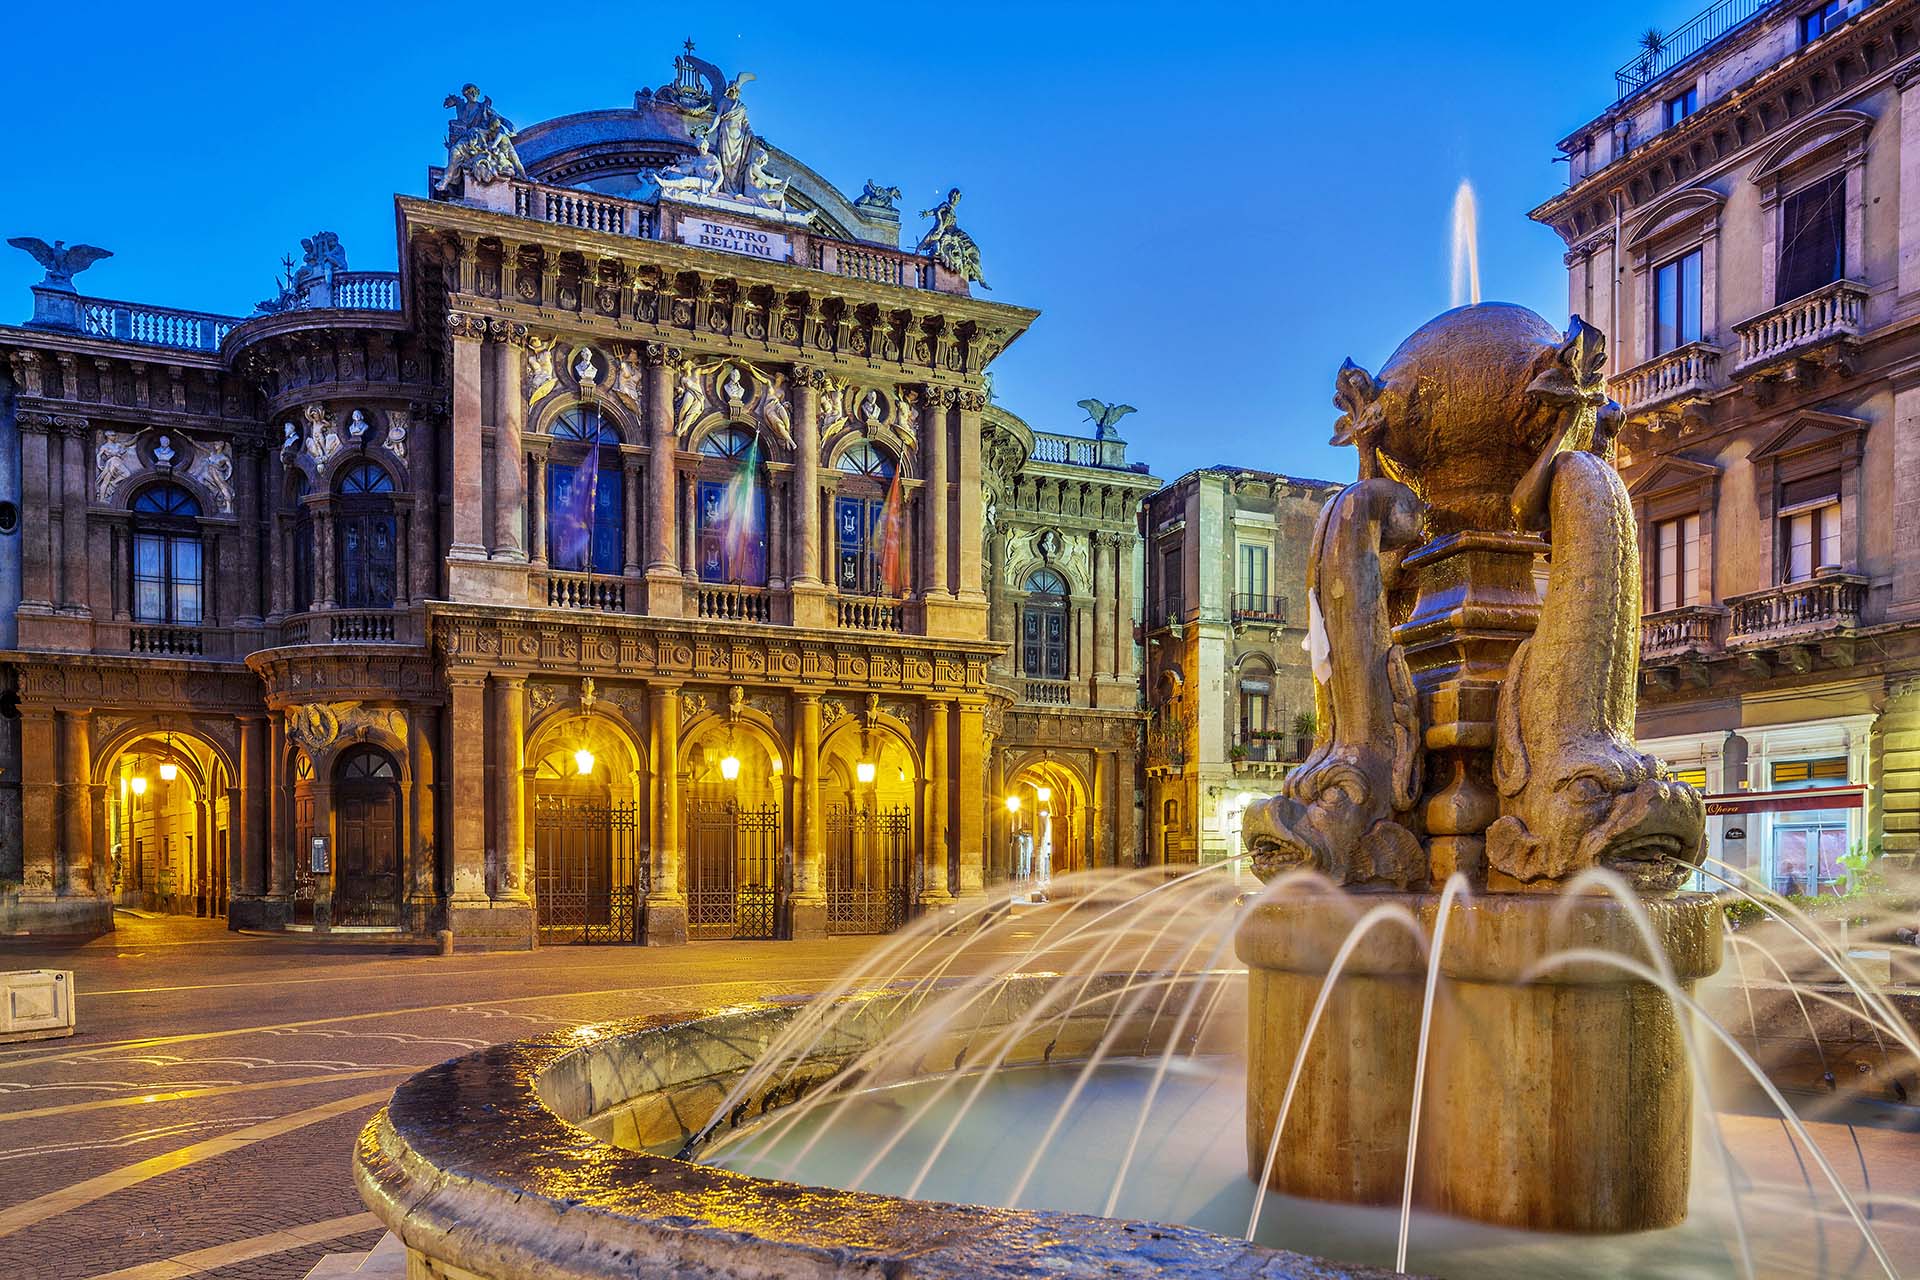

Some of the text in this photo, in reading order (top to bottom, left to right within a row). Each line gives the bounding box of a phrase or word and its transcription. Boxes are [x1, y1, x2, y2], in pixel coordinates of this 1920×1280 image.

[702, 223, 768, 244] TEATRO
[700, 235, 771, 256] BELLINI
[1707, 803, 1739, 816] Opera
